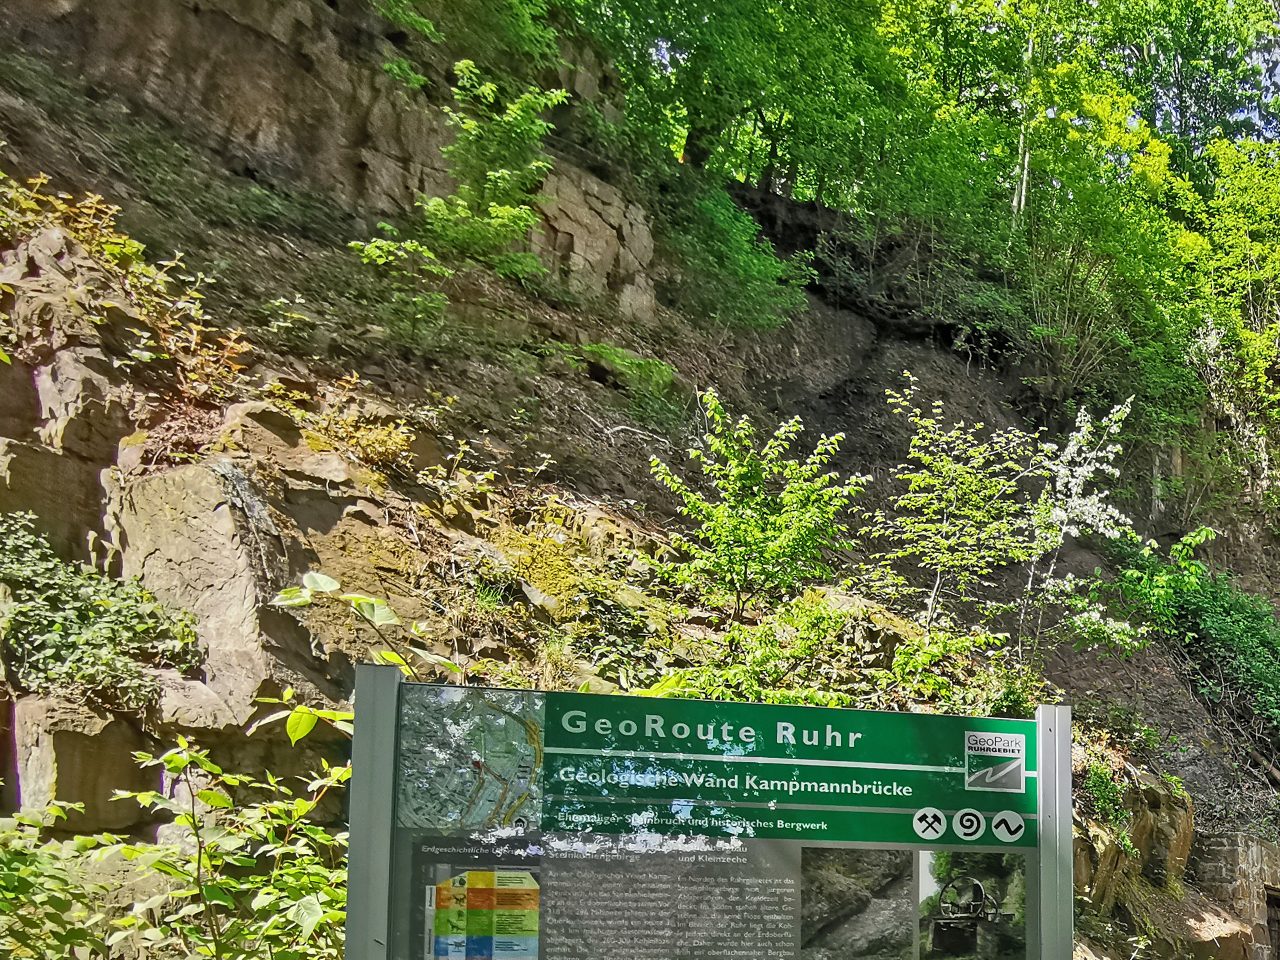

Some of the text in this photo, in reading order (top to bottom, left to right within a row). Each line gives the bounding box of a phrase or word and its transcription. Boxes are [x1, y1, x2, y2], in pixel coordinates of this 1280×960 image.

[561, 710, 862, 748] GeoRoute Ruhr
[967, 734, 1021, 748] GeoPark
[967, 745, 1021, 754] RUHRGEBIET
[559, 766, 913, 796] Geologische Wand Kampmannbrücke
[711, 817, 774, 828] historisches
[777, 820, 827, 831] Bergwerk
[698, 855, 748, 863] Kleinzeche
